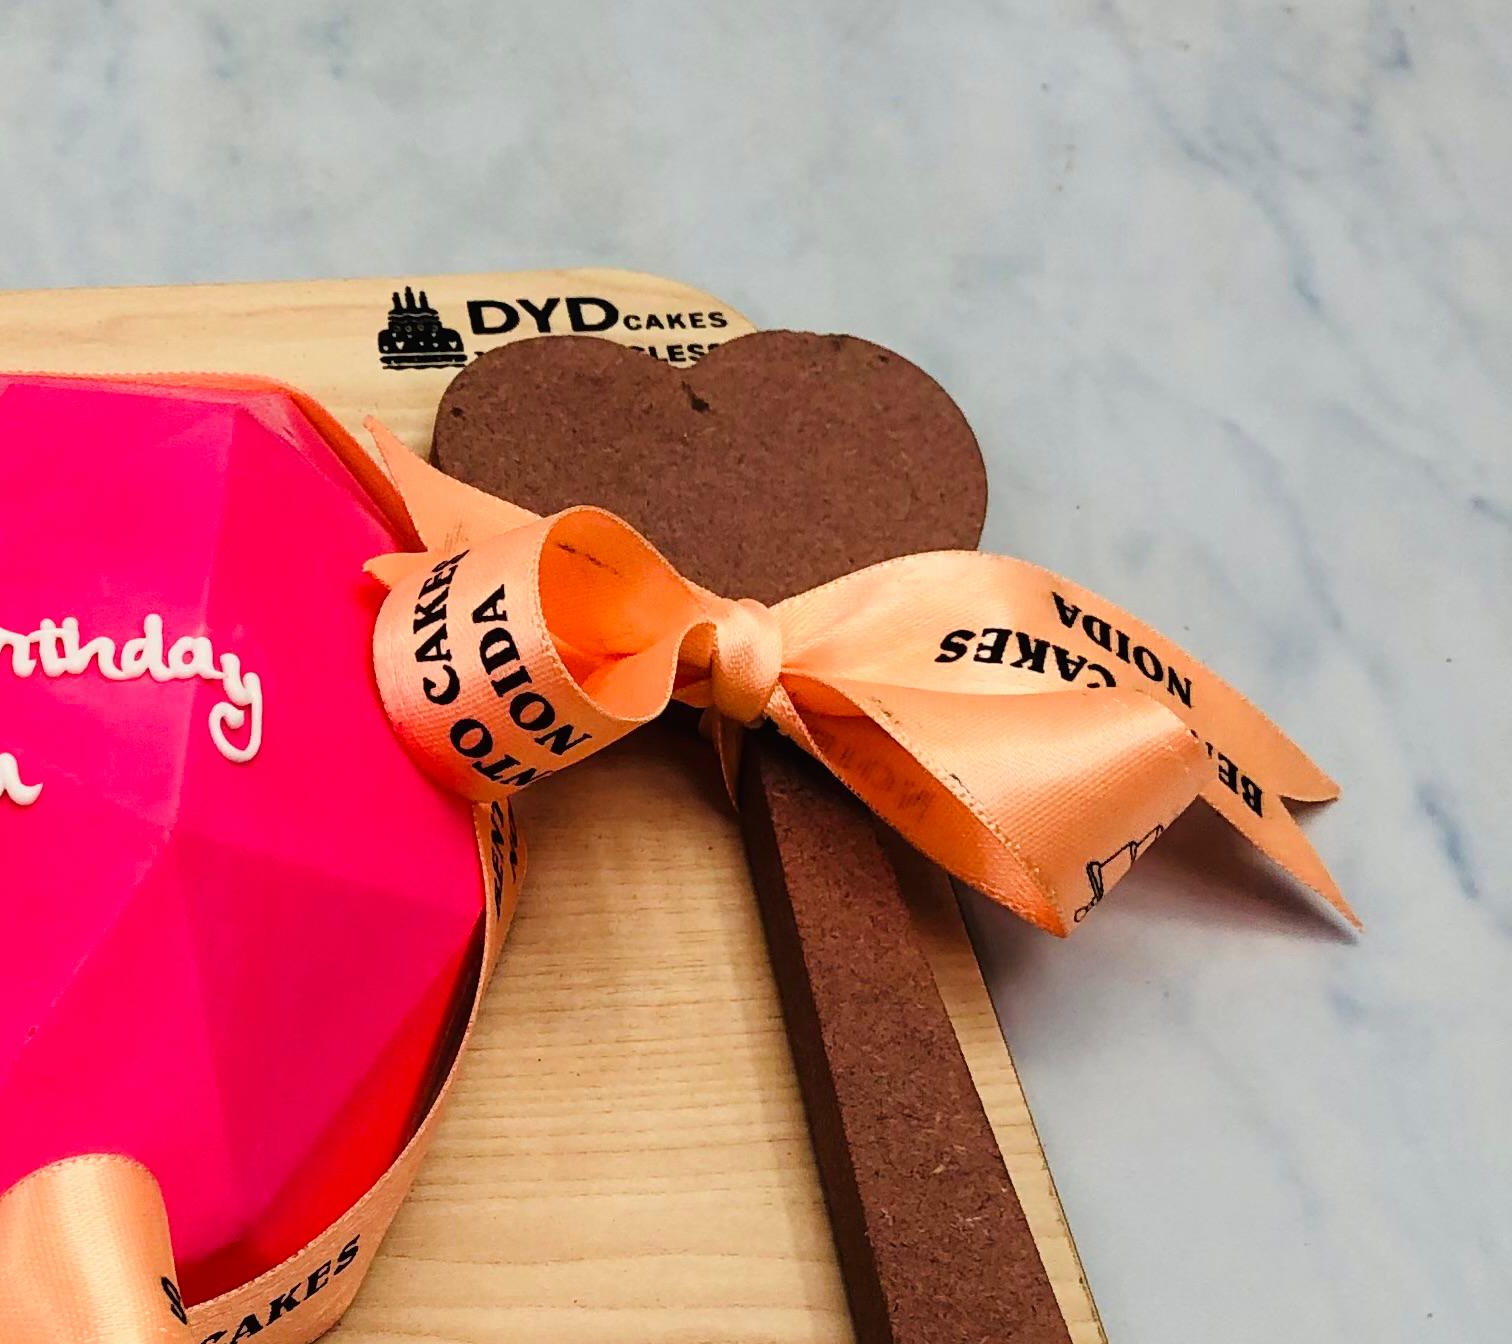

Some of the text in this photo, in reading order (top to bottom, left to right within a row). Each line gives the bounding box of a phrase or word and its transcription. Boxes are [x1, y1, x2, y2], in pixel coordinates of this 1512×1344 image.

[466, 297, 728, 335] DYD CAKES
[471, 584, 592, 755] NOIDA
[934, 628, 1116, 688] CAKES
[1051, 591, 1193, 709] NOIDA
